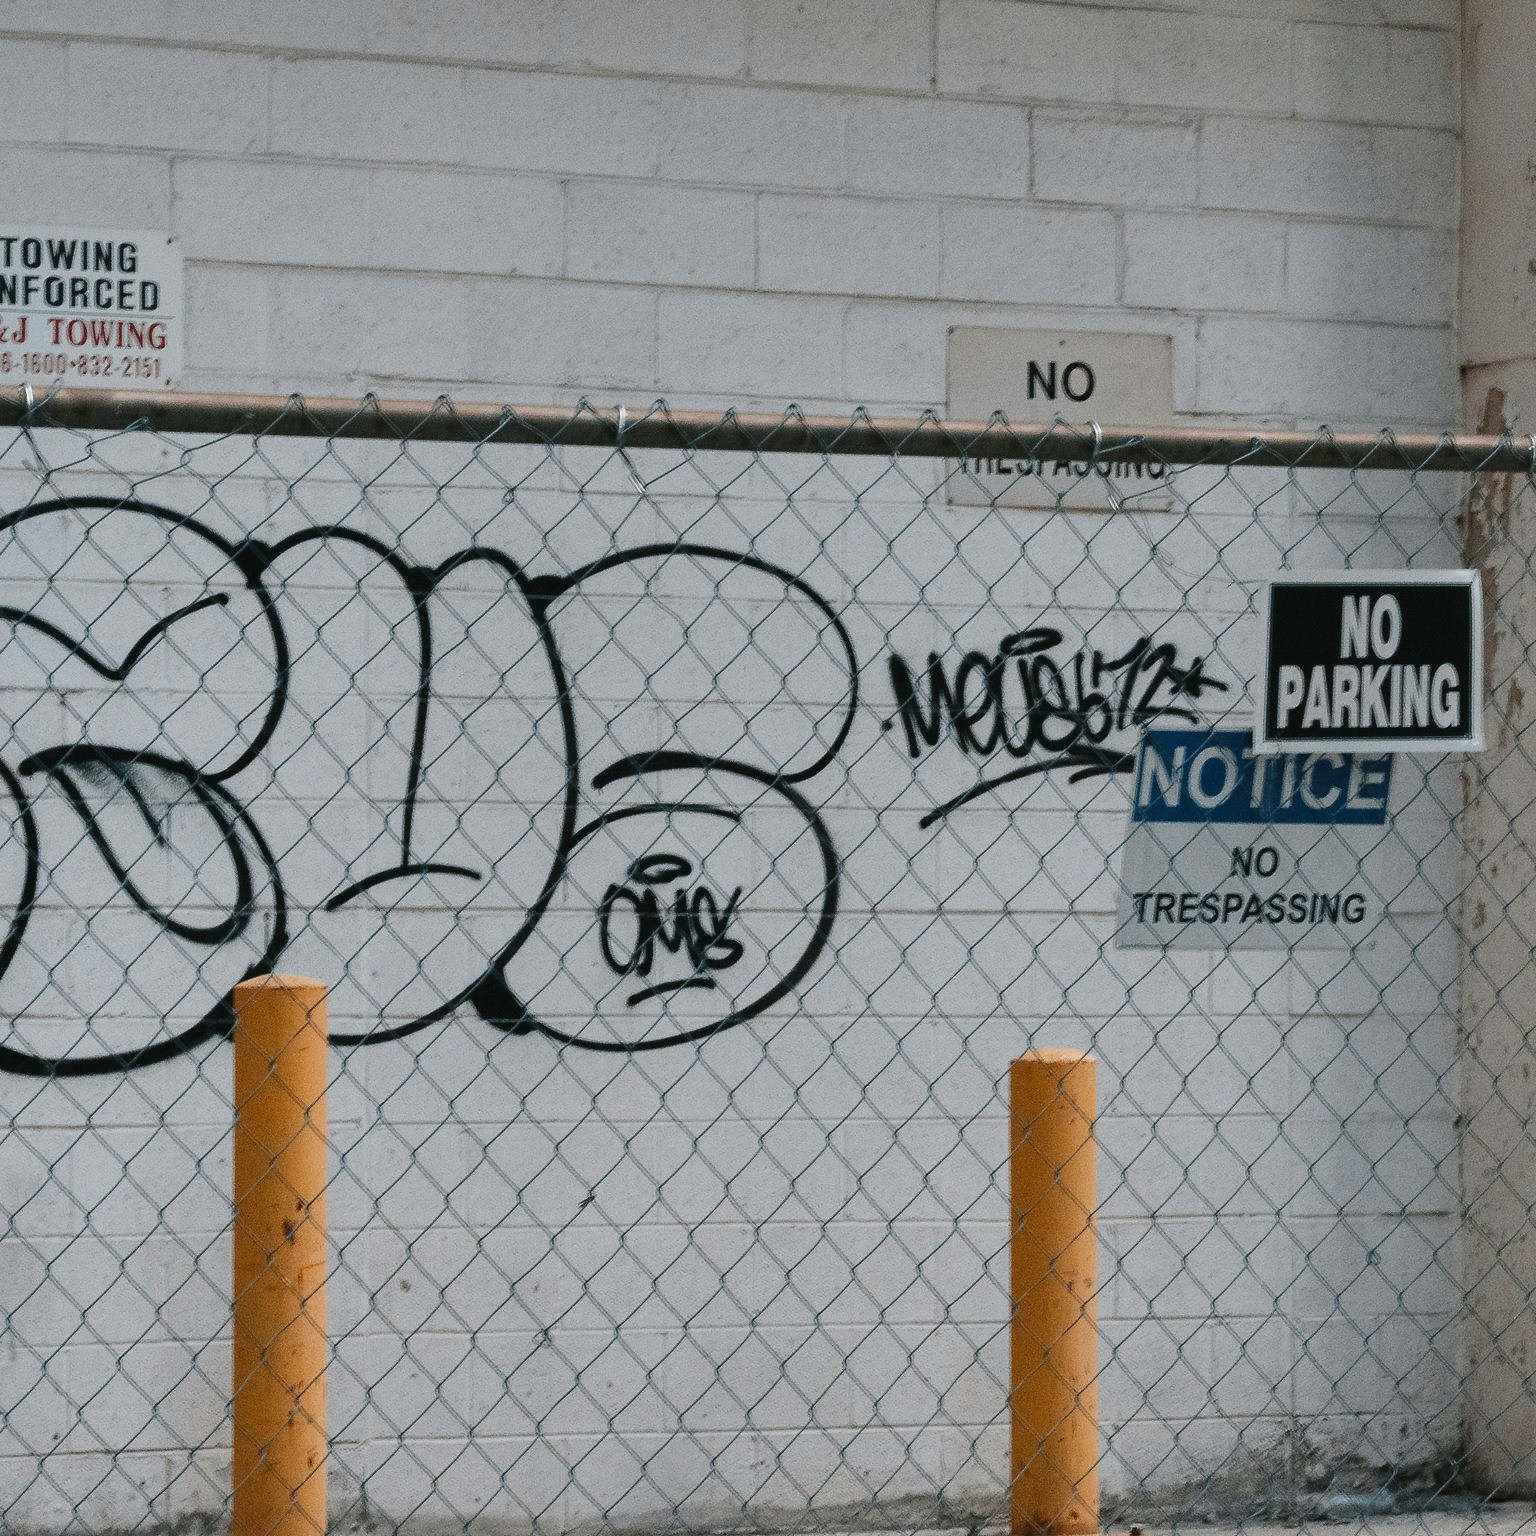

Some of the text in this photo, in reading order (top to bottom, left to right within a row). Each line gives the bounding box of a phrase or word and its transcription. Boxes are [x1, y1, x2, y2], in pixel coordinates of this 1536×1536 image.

[48, 318, 168, 350] TOWING
[1026, 360, 1095, 402] NO
[1339, 593, 1403, 661] NO
[1276, 662, 1461, 730] PARKING
[1137, 745, 1390, 810] NOTICE
[1230, 846, 1280, 878] NO
[1132, 892, 1367, 925] TRESPASSING
